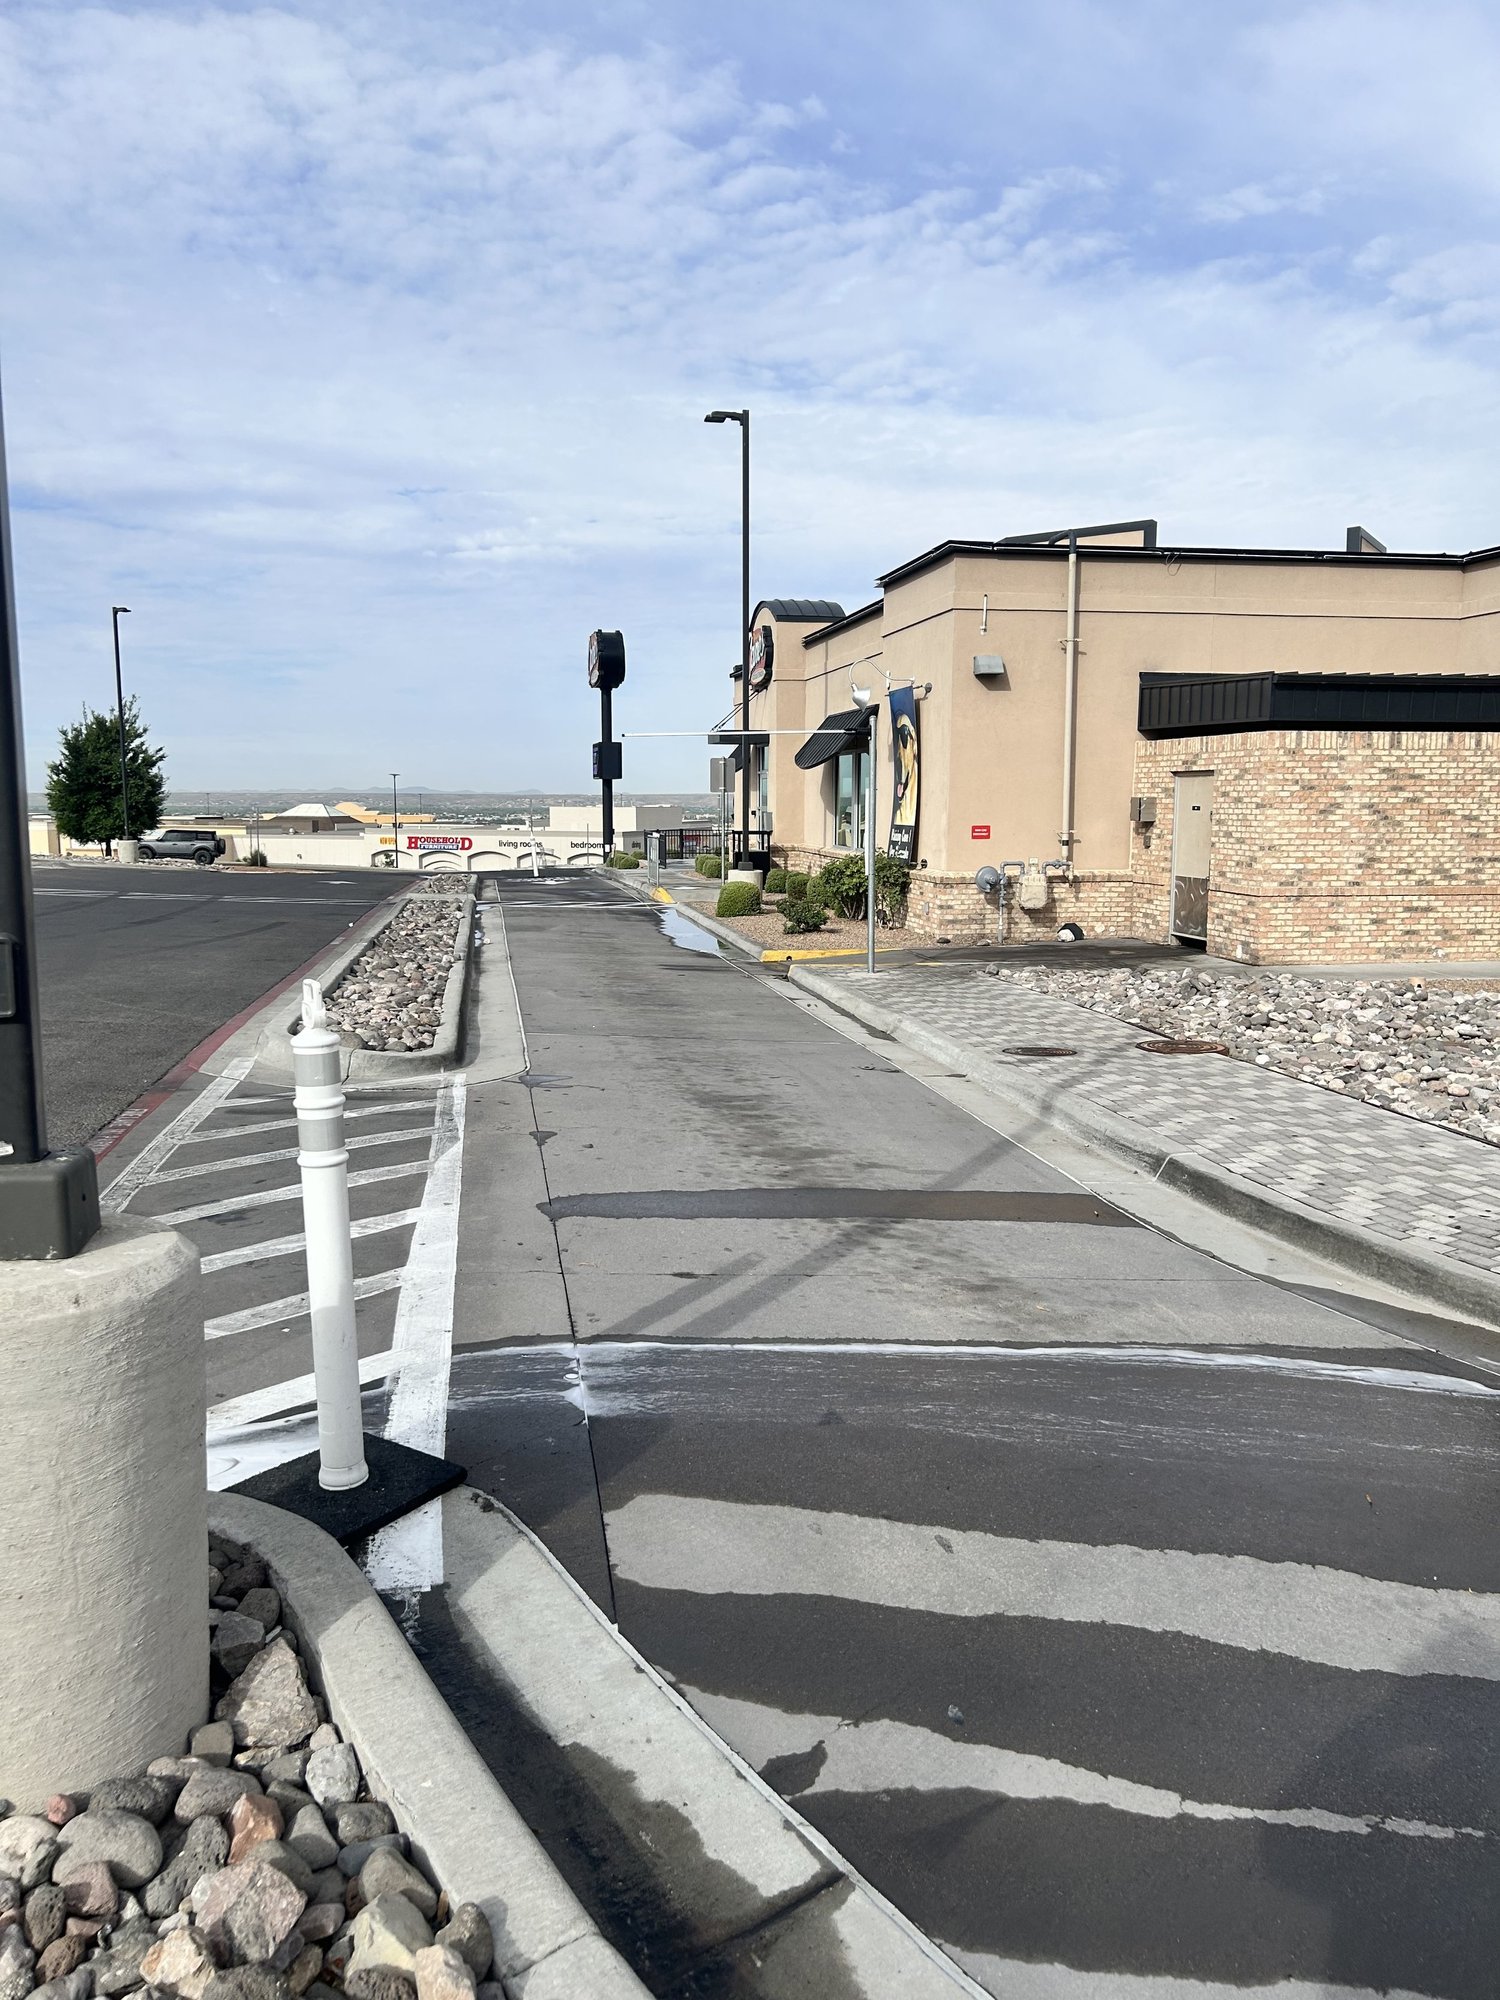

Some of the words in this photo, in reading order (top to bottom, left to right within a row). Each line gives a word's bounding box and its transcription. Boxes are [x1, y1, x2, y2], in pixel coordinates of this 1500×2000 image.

[407, 836, 473, 851] HOUSEHOLD
[498, 840, 518, 849] living
[570, 840, 604, 849] bedroom
